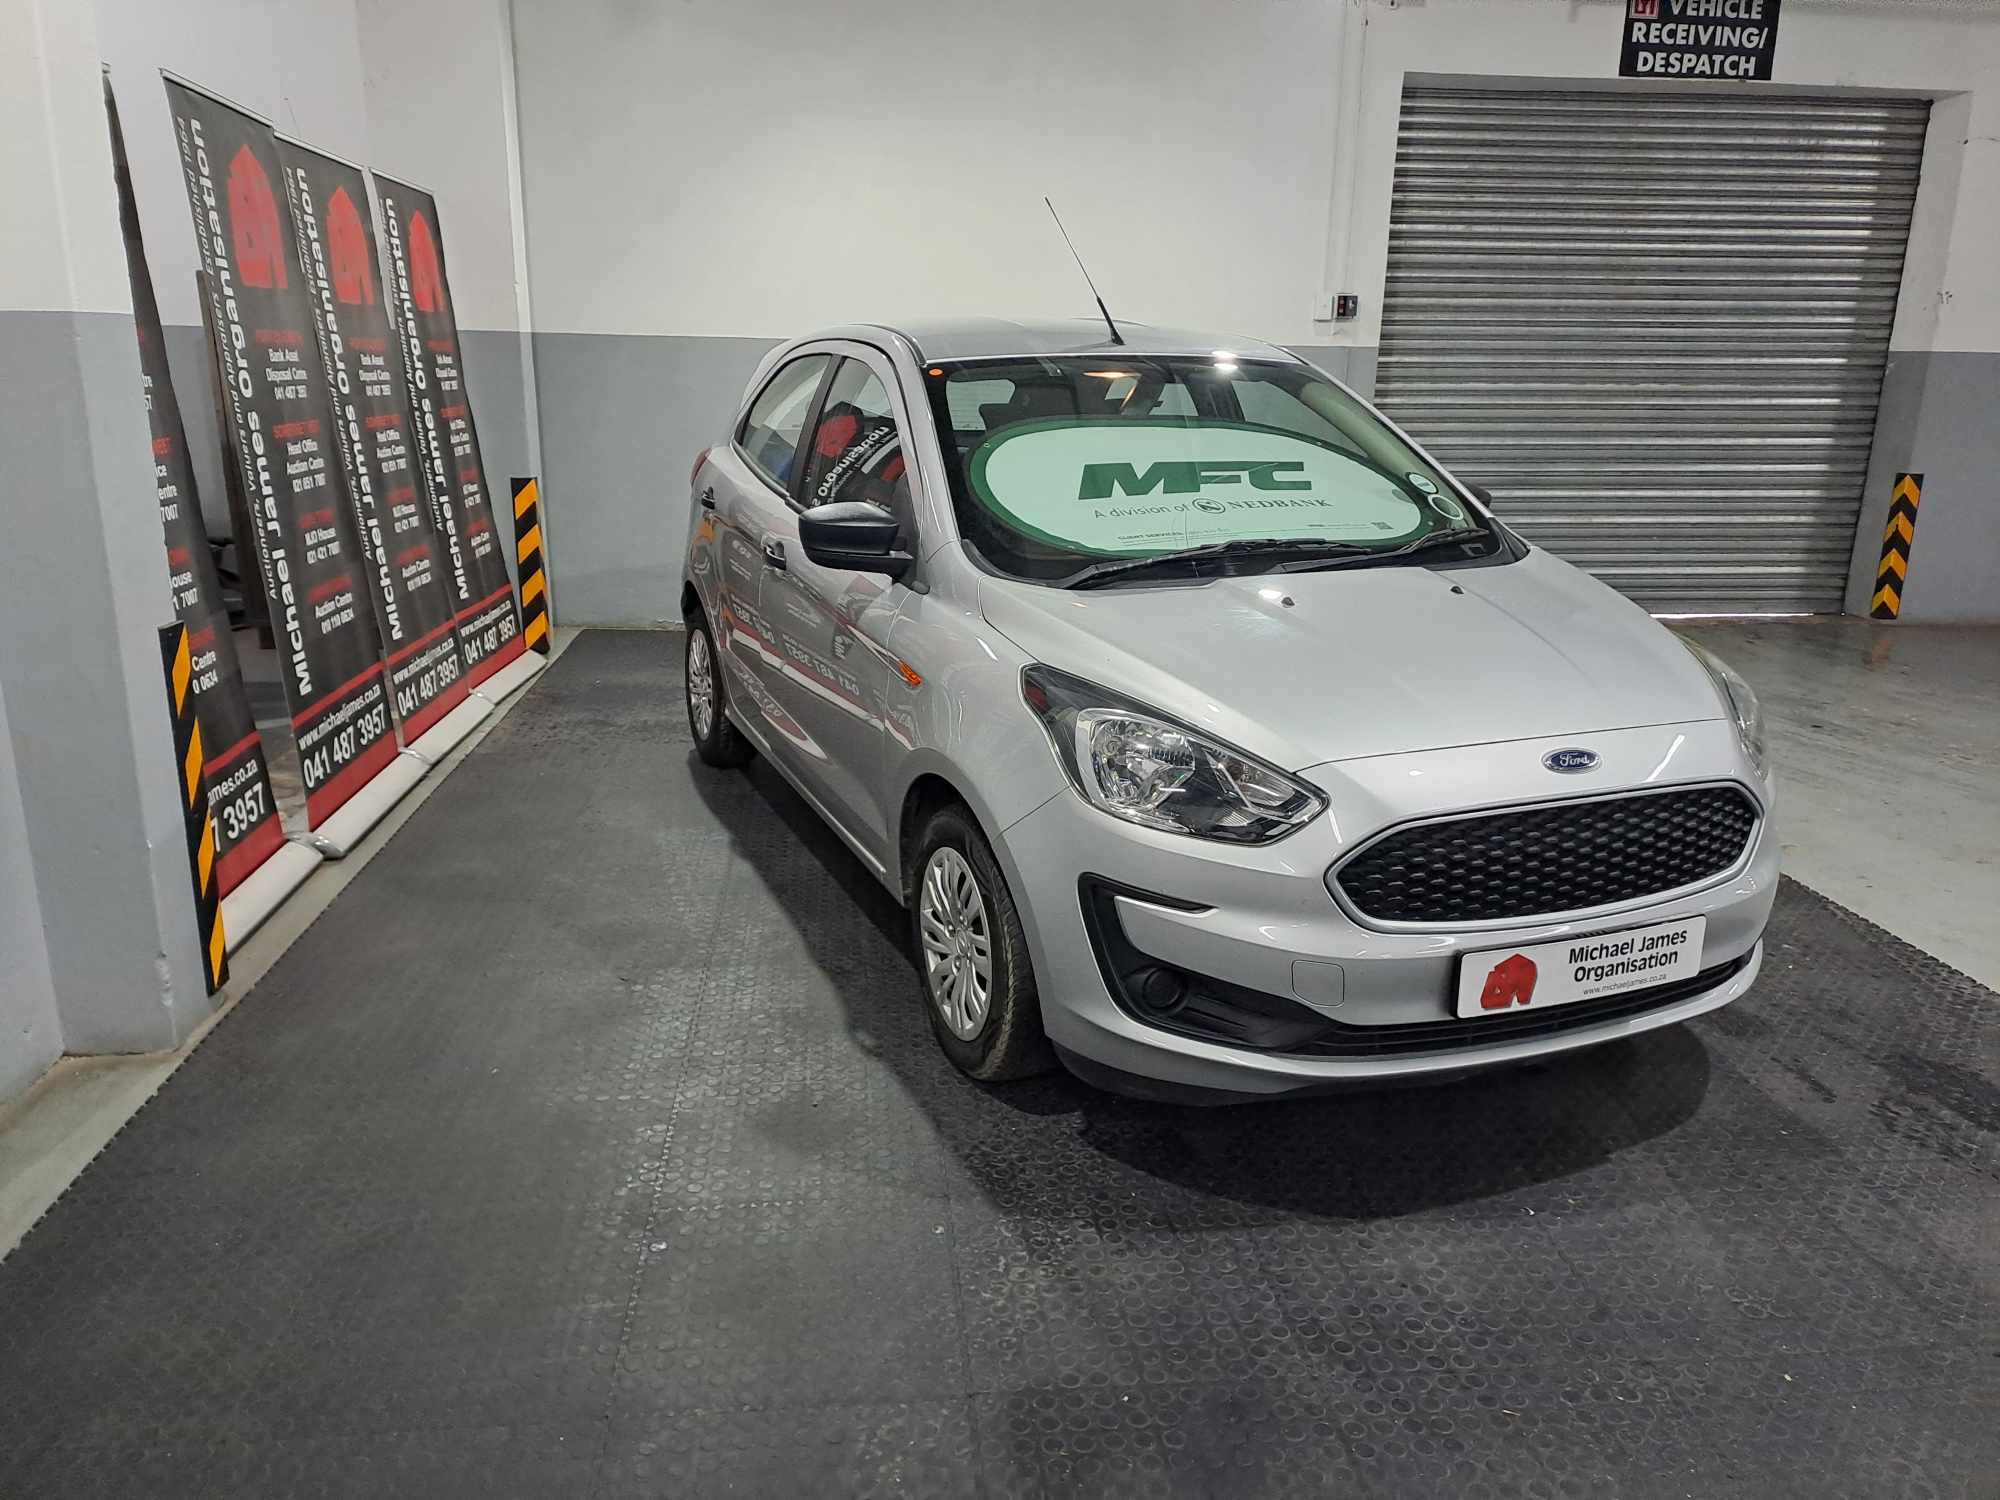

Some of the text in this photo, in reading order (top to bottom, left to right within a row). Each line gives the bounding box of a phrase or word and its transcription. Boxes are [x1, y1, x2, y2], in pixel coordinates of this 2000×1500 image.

[1671, 0, 1762, 19] VEHICLE
[1631, 22, 1768, 48] RECEIVING/
[1636, 51, 1756, 76] DESPATCH
[296, 168, 350, 394] Organisation
[386, 198, 426, 390] Organisation
[190, 118, 312, 696] Michael James Organisation
[230, 389, 243, 423] and
[345, 404, 375, 509] James
[422, 398, 447, 487] James
[158, 484, 178, 500] entre
[1078, 461, 1312, 500] MFC
[1094, 499, 1334, 518] A division of NEDBANK
[439, 495, 469, 600] Michael
[367, 518, 403, 640] Michael
[192, 648, 217, 673] Centre
[464, 614, 517, 665] 041 487 3957
[397, 653, 459, 716] 041 487 3957
[303, 702, 386, 788] 041 487 3957
[1559, 752, 1590, 767] Ford
[208, 758, 258, 807] ames.co.za
[223, 782, 265, 841] 3957
[1568, 930, 1688, 964] Michael James
[1573, 950, 1679, 982] Organisation
